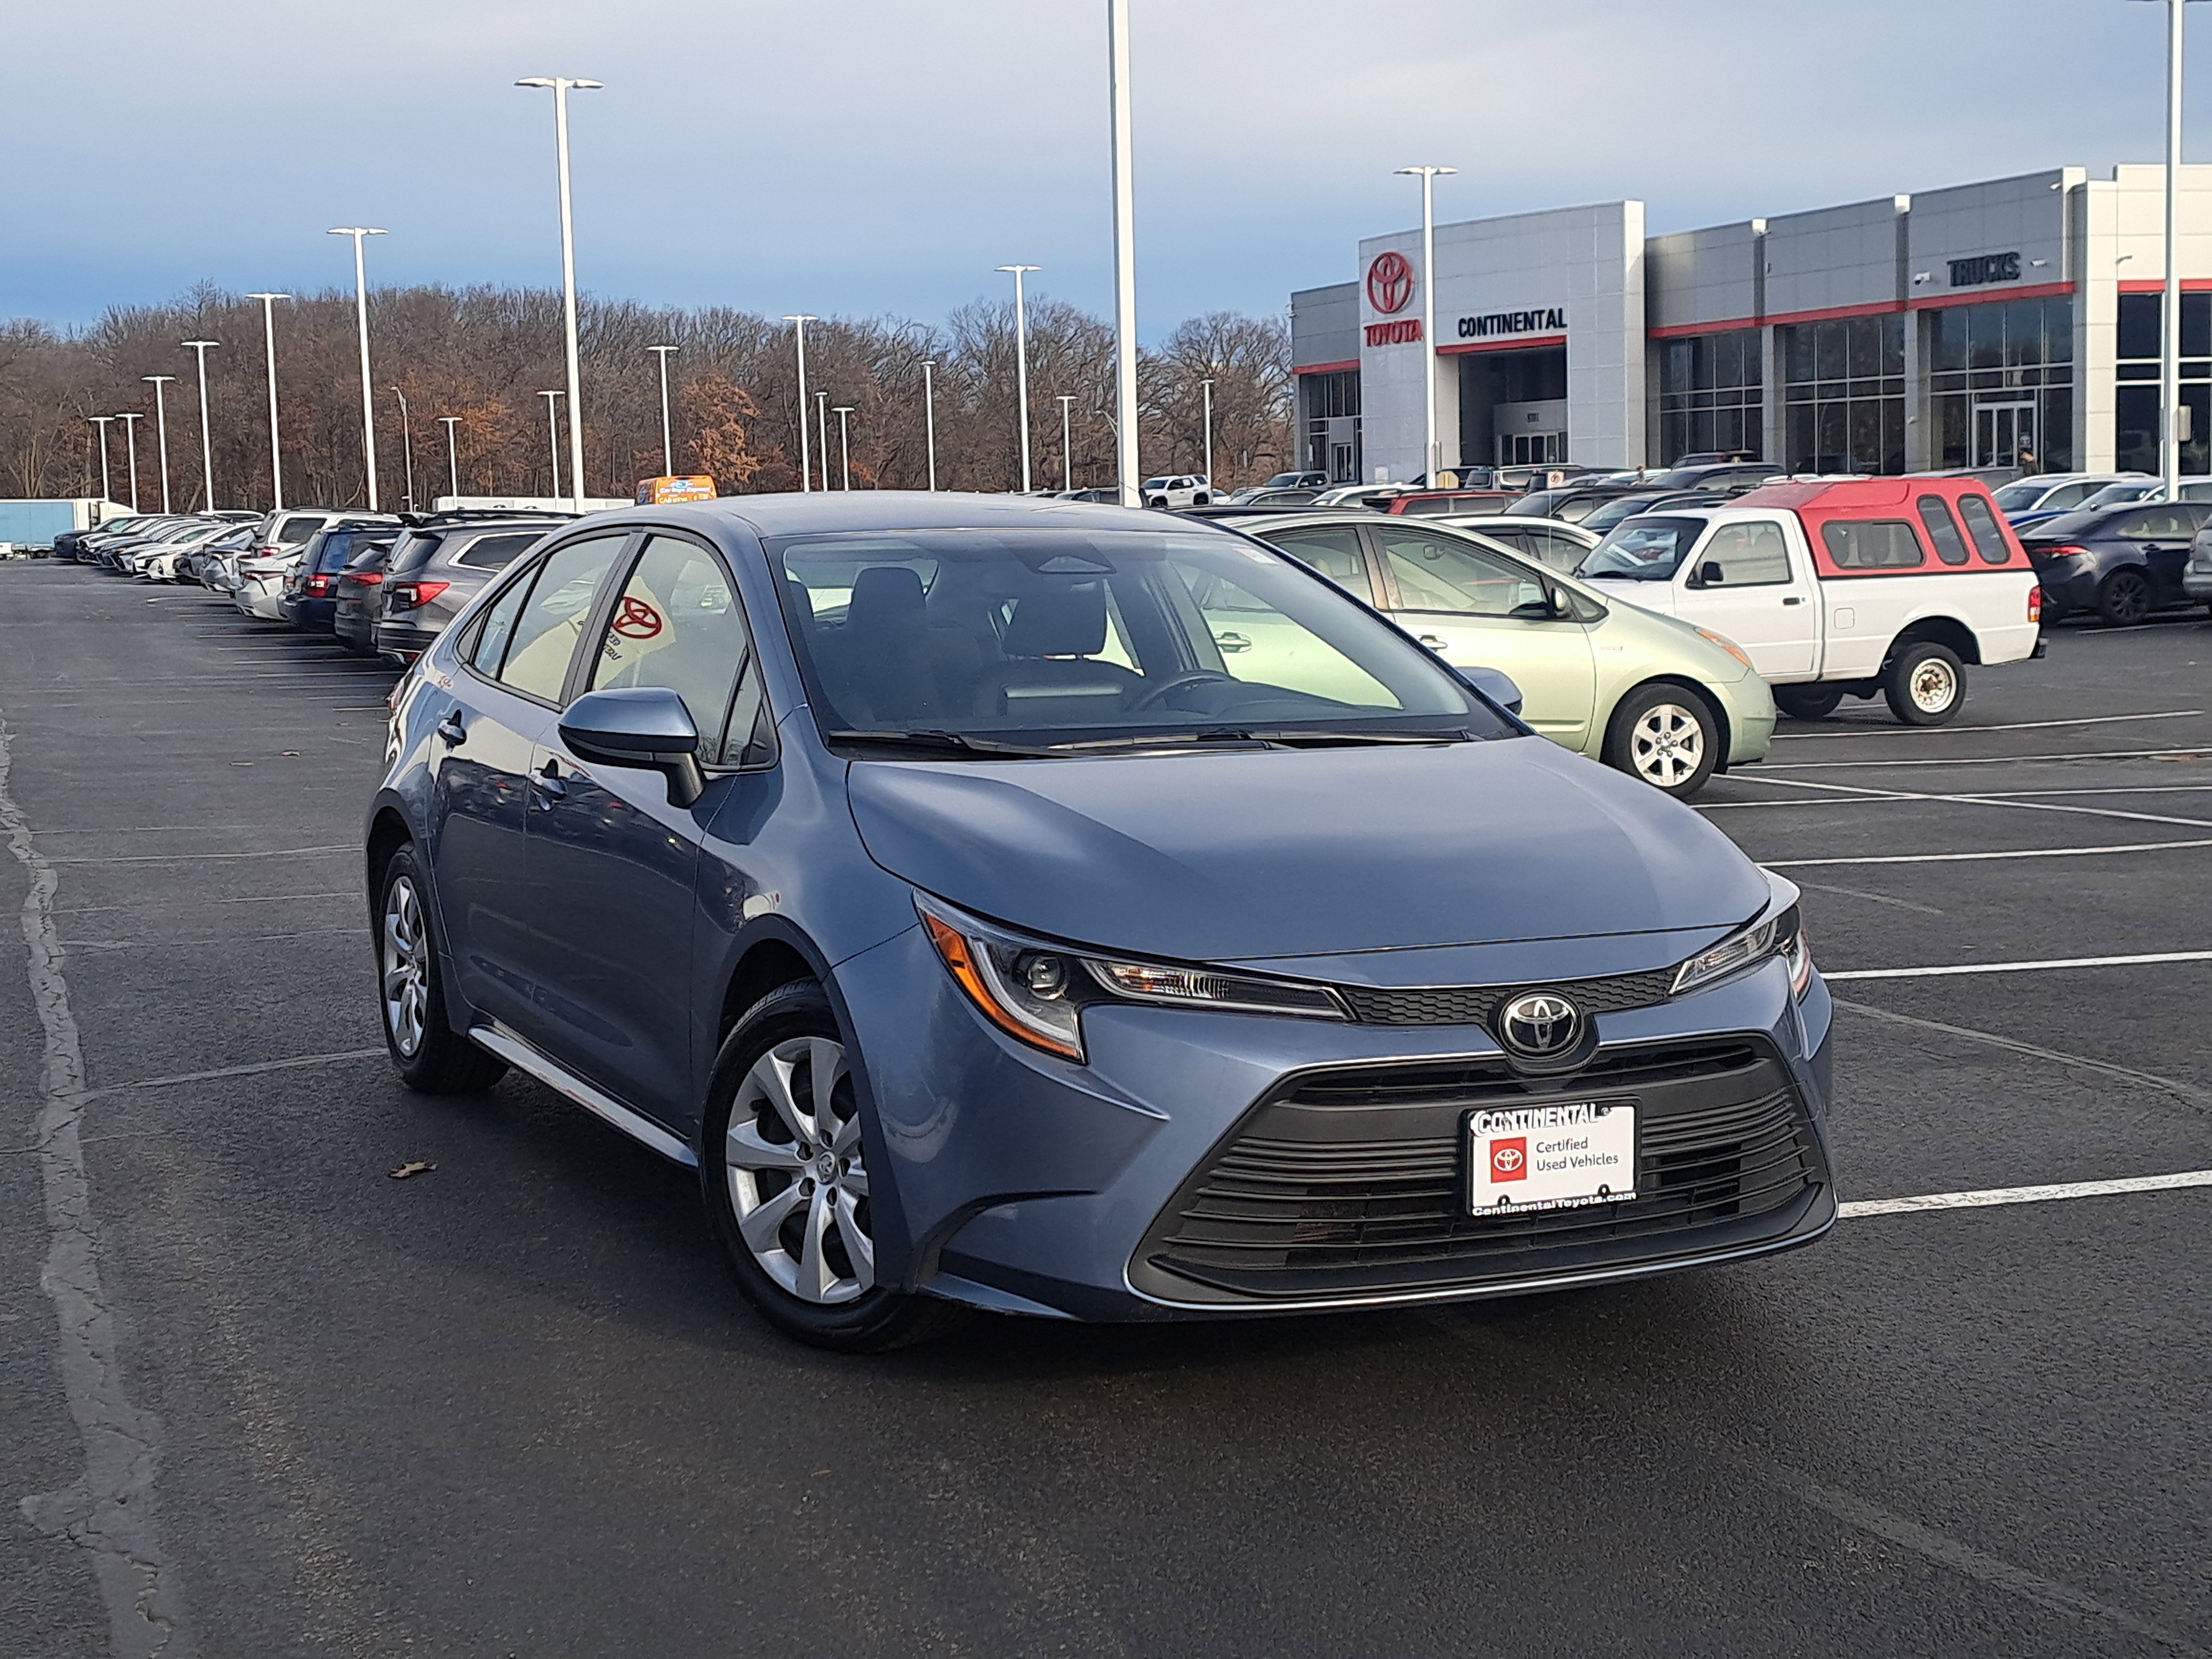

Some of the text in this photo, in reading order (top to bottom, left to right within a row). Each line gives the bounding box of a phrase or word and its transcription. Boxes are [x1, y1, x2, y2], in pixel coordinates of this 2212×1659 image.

[1947, 252, 2020, 287] TRUCKS
[1364, 319, 1423, 347] TOYOTA
[1458, 307, 1568, 338] CONTINENTAL
[1478, 1102, 1599, 1134] CONTINENTAL
[1536, 1136, 1588, 1153] Certified
[1537, 1152, 1619, 1171] Used Vehicles
[1472, 1192, 1637, 1216] ContinentalToyota.com
